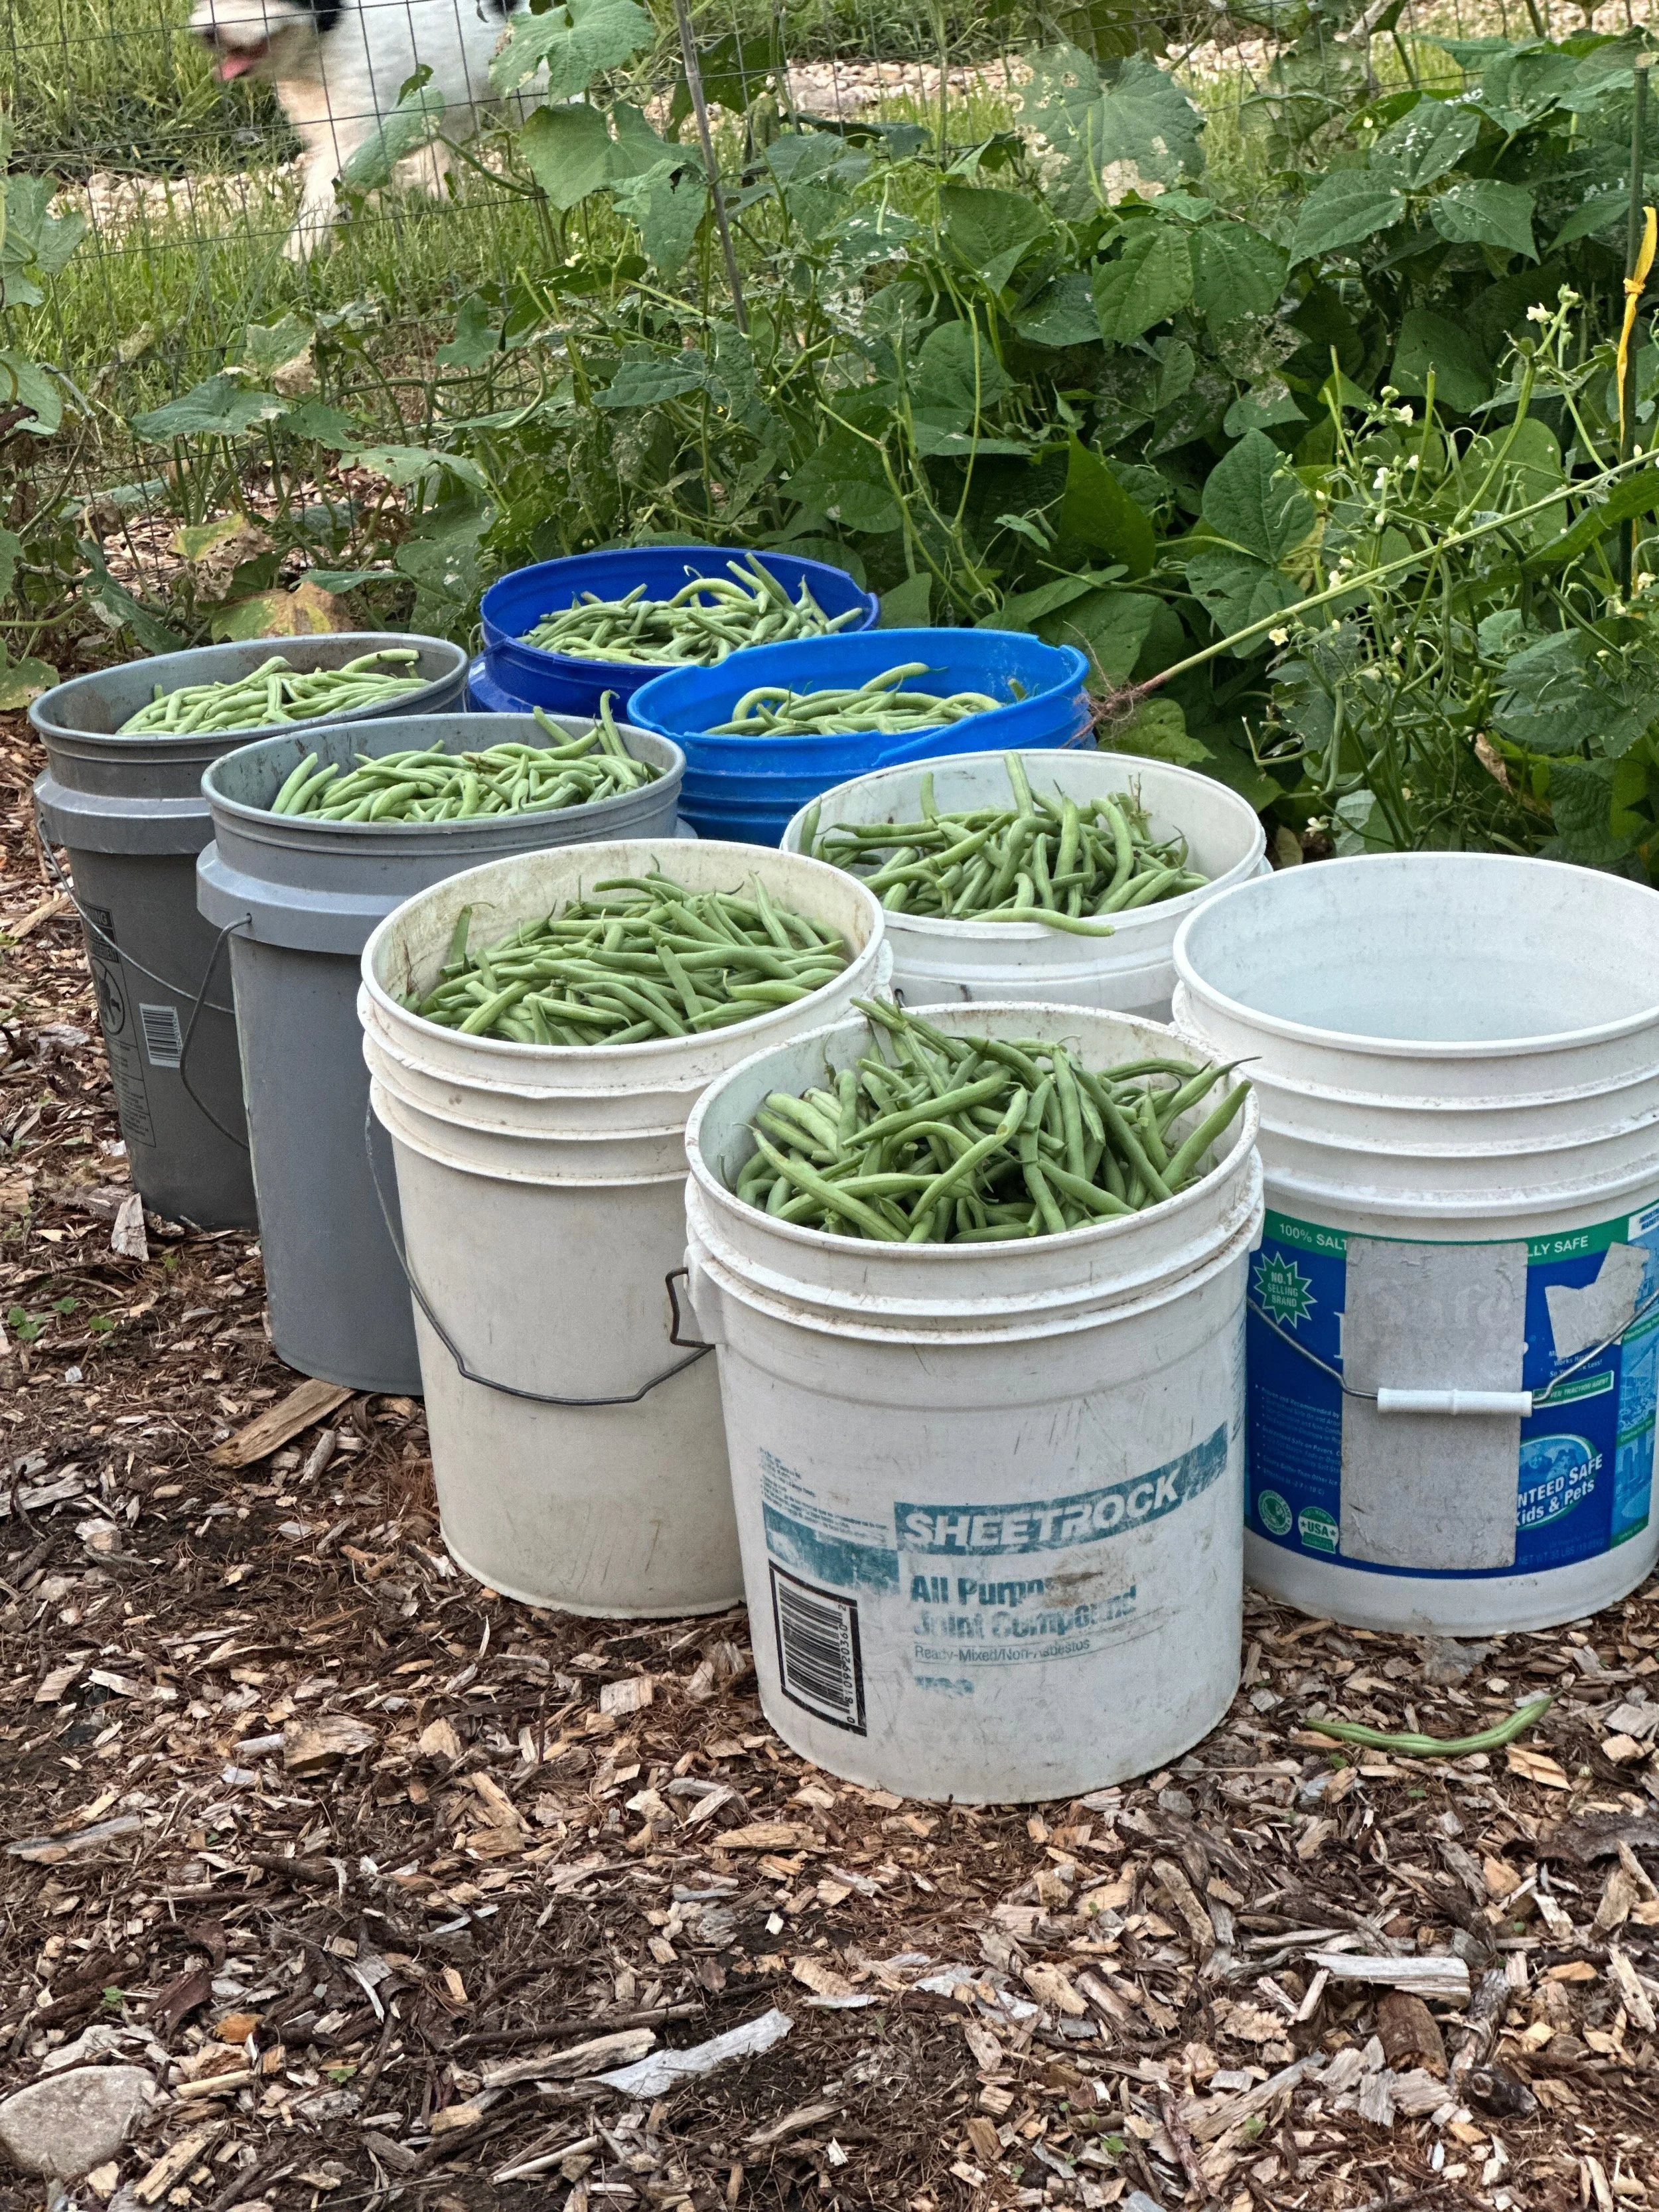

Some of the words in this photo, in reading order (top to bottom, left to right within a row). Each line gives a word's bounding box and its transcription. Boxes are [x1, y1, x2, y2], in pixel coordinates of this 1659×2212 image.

[1279, 1223, 1313, 1243] 100%
[1554, 1235, 1589, 1253] SAFE
[1267, 1283, 1298, 1297] SELLING
[1271, 1295, 1297, 1307] BRAND
[1563, 1382, 1591, 1396] TRACTION
[1569, 1453, 1603, 1485] SAFE
[1548, 1496, 1560, 1512] &
[1564, 1479, 1595, 1505] Pets
[904, 1467, 1182, 1547] SHEETROCK
[1307, 1521, 1329, 1538] USA
[910, 1575, 950, 1604] All
